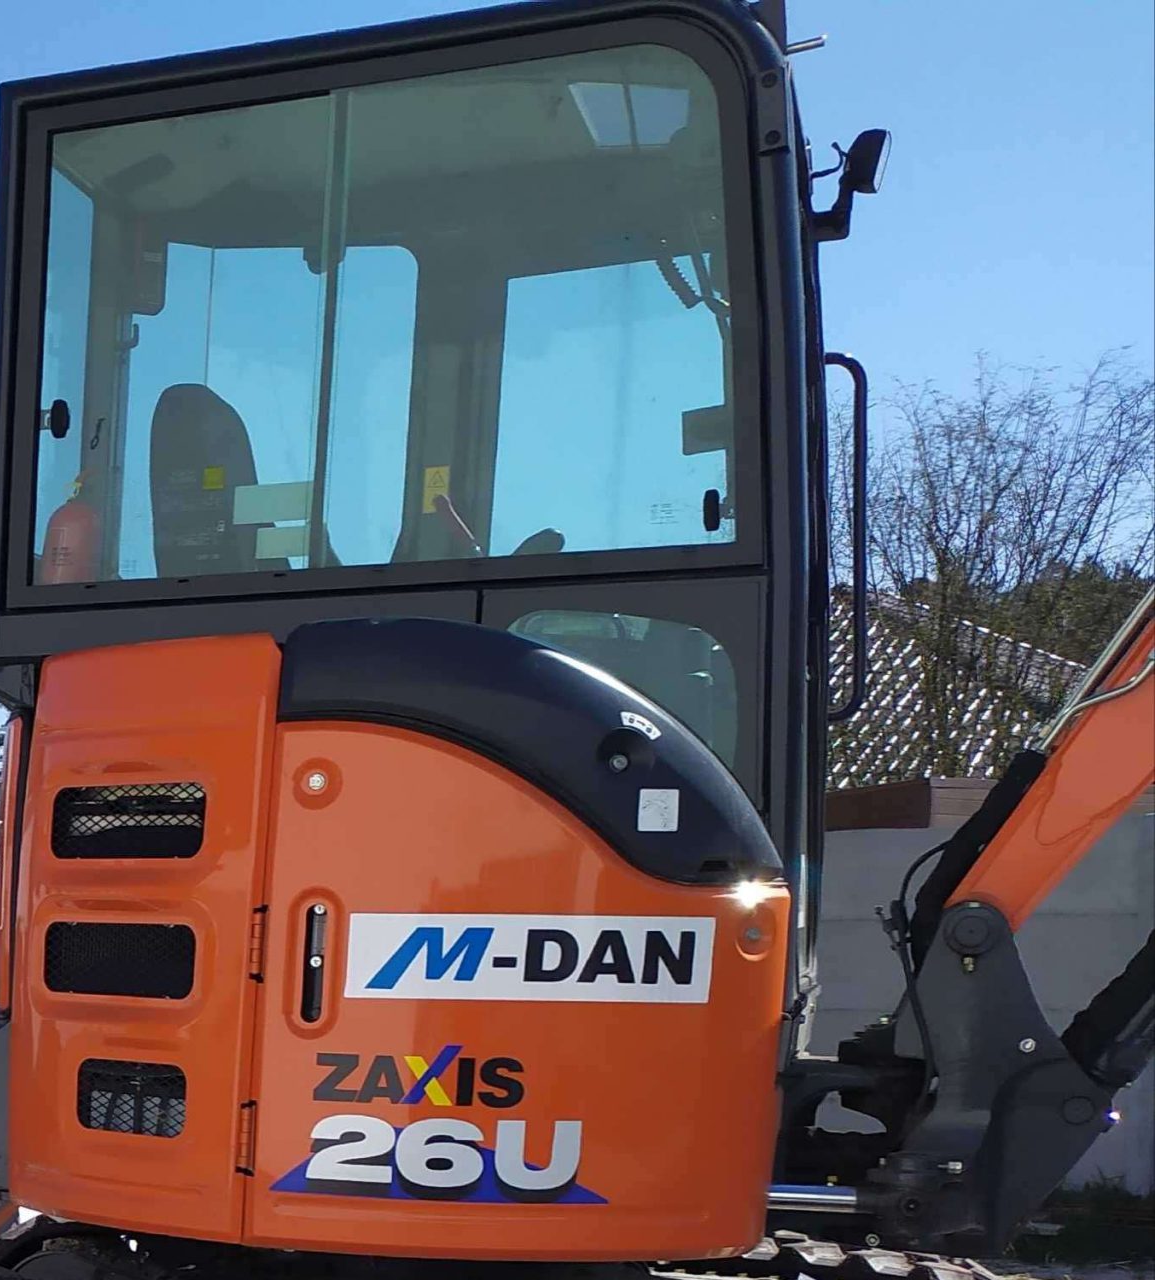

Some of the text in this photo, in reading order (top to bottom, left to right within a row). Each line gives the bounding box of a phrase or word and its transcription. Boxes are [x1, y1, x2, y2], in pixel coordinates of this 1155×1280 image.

[364, 926, 697, 990] M-DAN
[313, 1045, 525, 1108] ZAXIS
[306, 1114, 582, 1191] 26U
